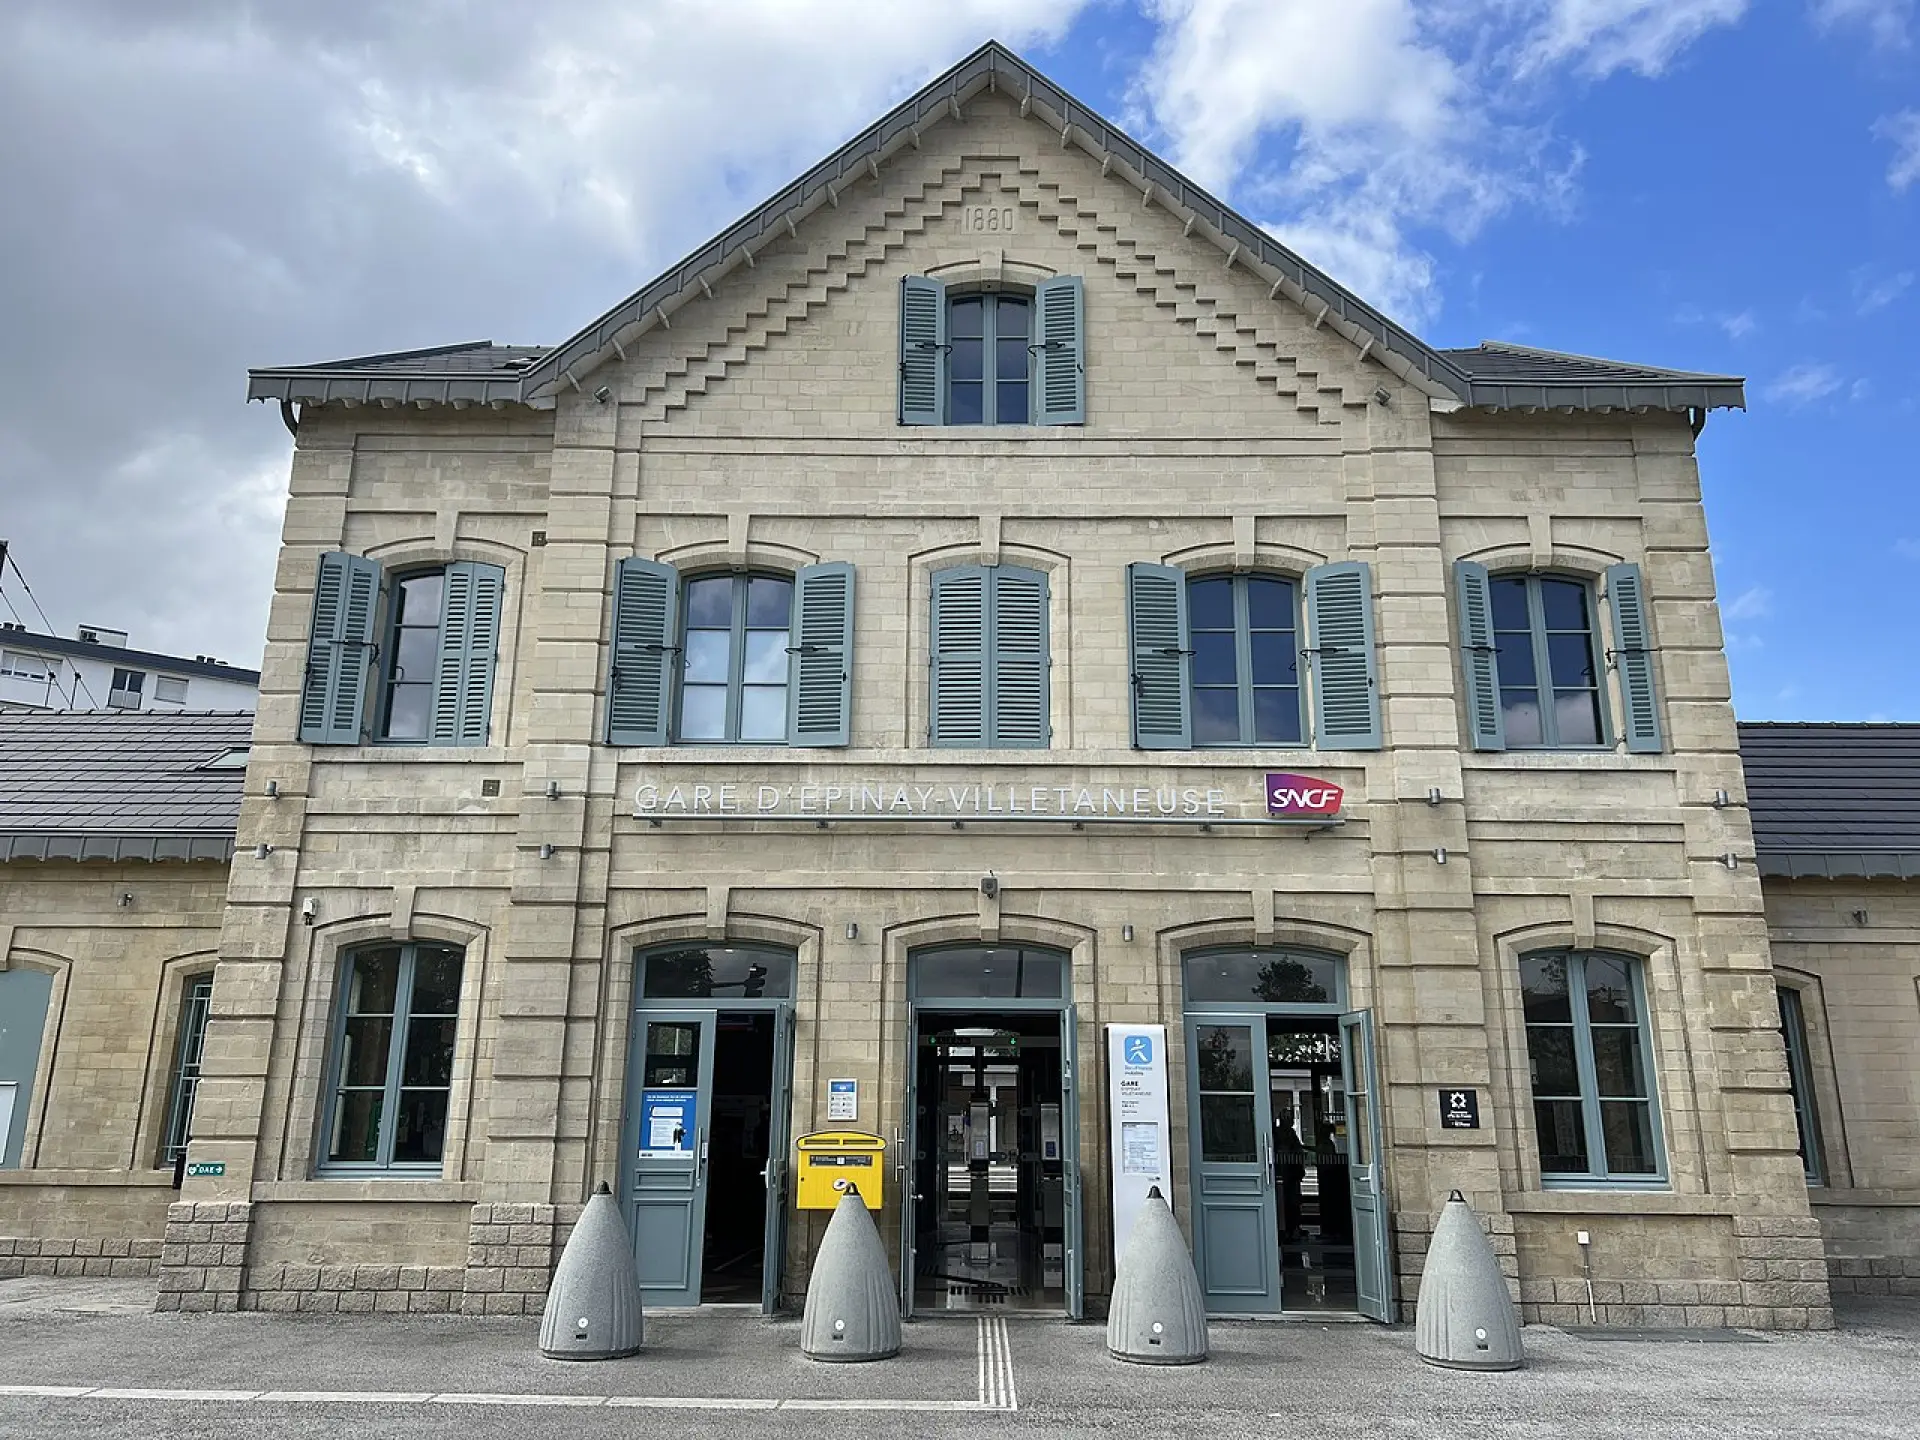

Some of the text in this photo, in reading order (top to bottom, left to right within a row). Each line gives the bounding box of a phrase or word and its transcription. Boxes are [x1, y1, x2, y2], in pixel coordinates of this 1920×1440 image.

[965, 208, 1013, 231] 1880
[635, 785, 1225, 814] GARE D'EPINAY-VILLETANEUSE
[1270, 789, 1338, 808] SNCF
